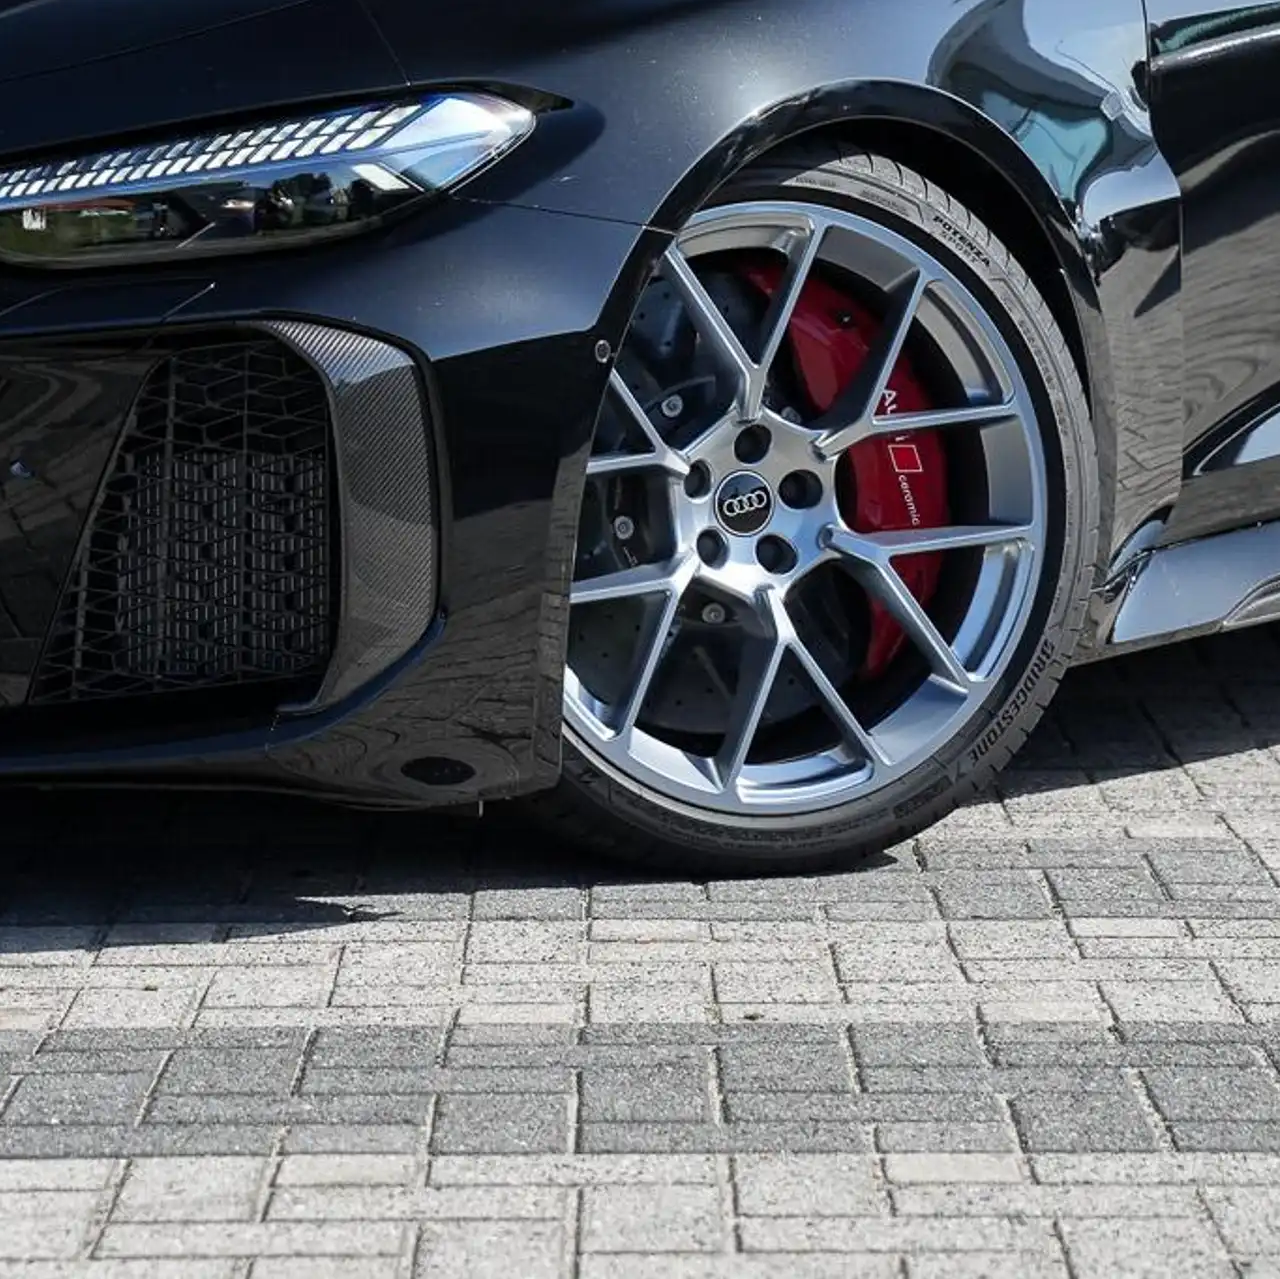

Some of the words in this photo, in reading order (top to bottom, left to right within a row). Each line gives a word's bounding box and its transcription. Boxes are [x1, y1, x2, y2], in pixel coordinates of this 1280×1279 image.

[932, 216, 991, 268] POTENZA
[939, 230, 977, 264] SPORT
[898, 474, 921, 526] ceramic
[969, 638, 1056, 765] BRIDGESTONE
